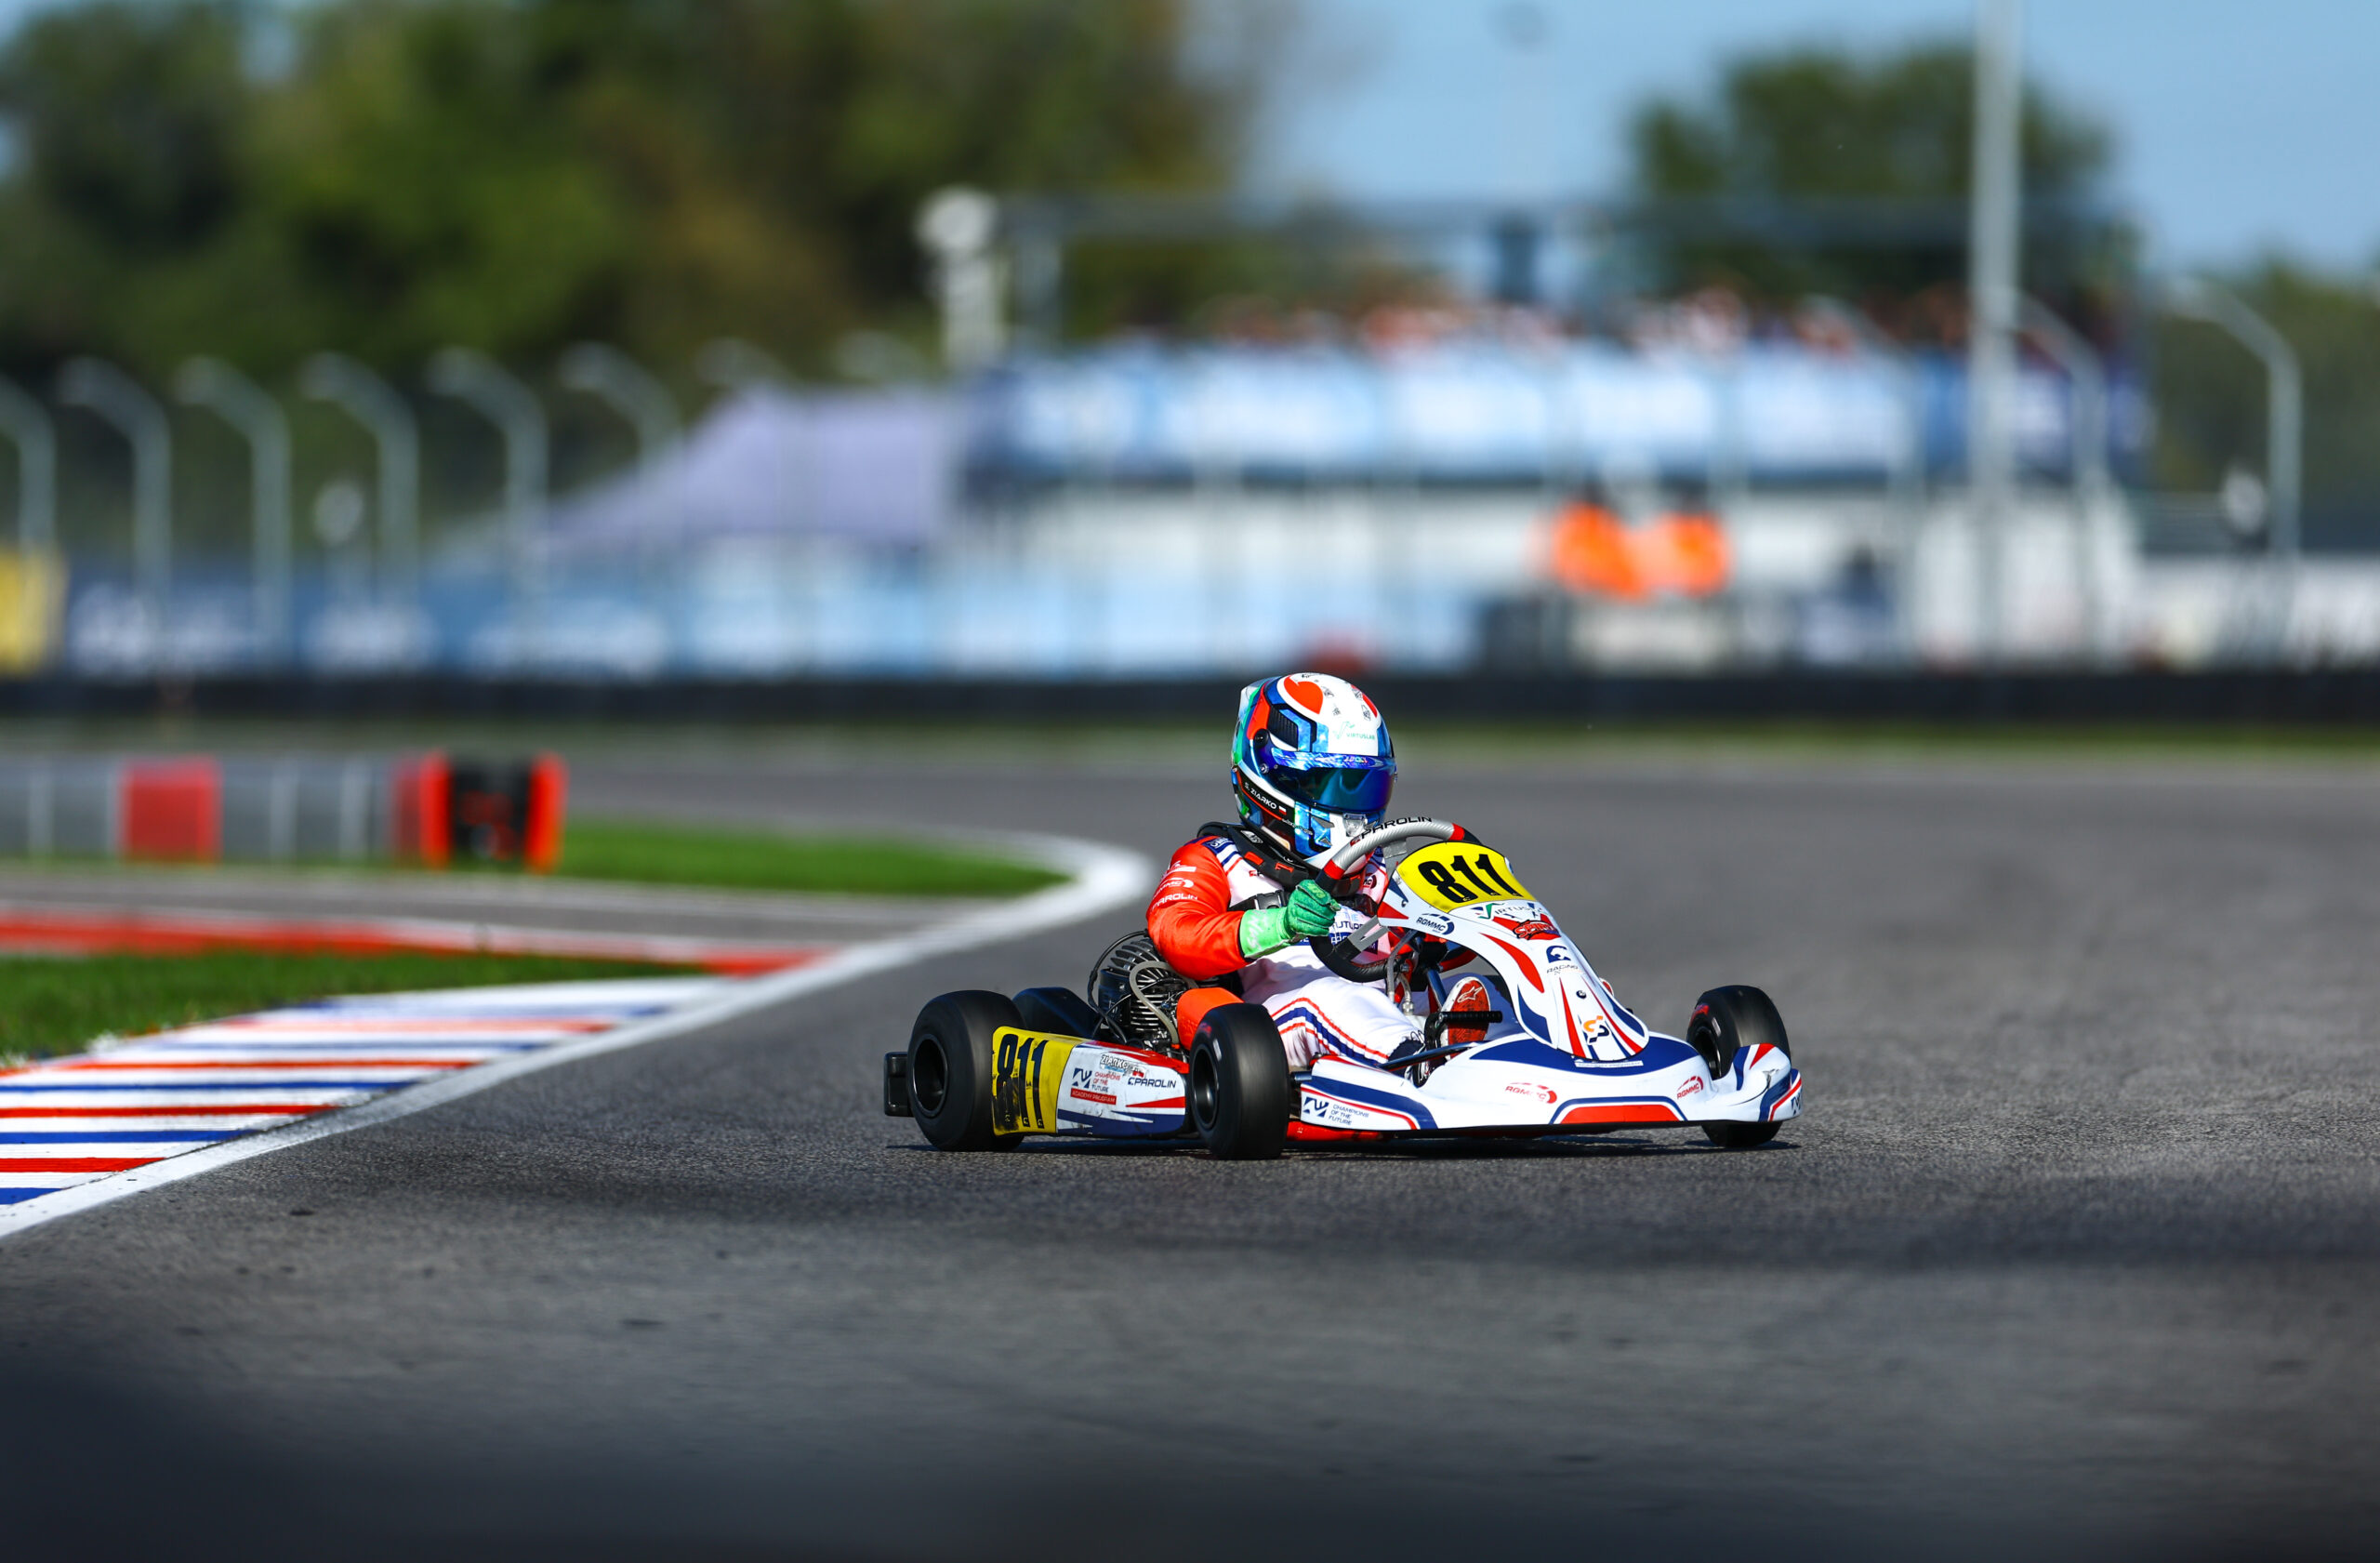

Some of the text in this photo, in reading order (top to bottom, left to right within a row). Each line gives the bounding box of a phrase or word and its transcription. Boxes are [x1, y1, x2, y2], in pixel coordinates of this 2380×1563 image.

[1250, 788, 1277, 810] ZIARKO
[1361, 816, 1433, 839] PAROLIN
[1418, 854, 1524, 903] 811
[1416, 917, 1446, 932] RGMMC
[1100, 1053, 1128, 1069] ZIARKO
[996, 1033, 1050, 1131] 811
[1134, 1078, 1177, 1089] PAROLIN
[1677, 1082, 1700, 1100] RGMMC
